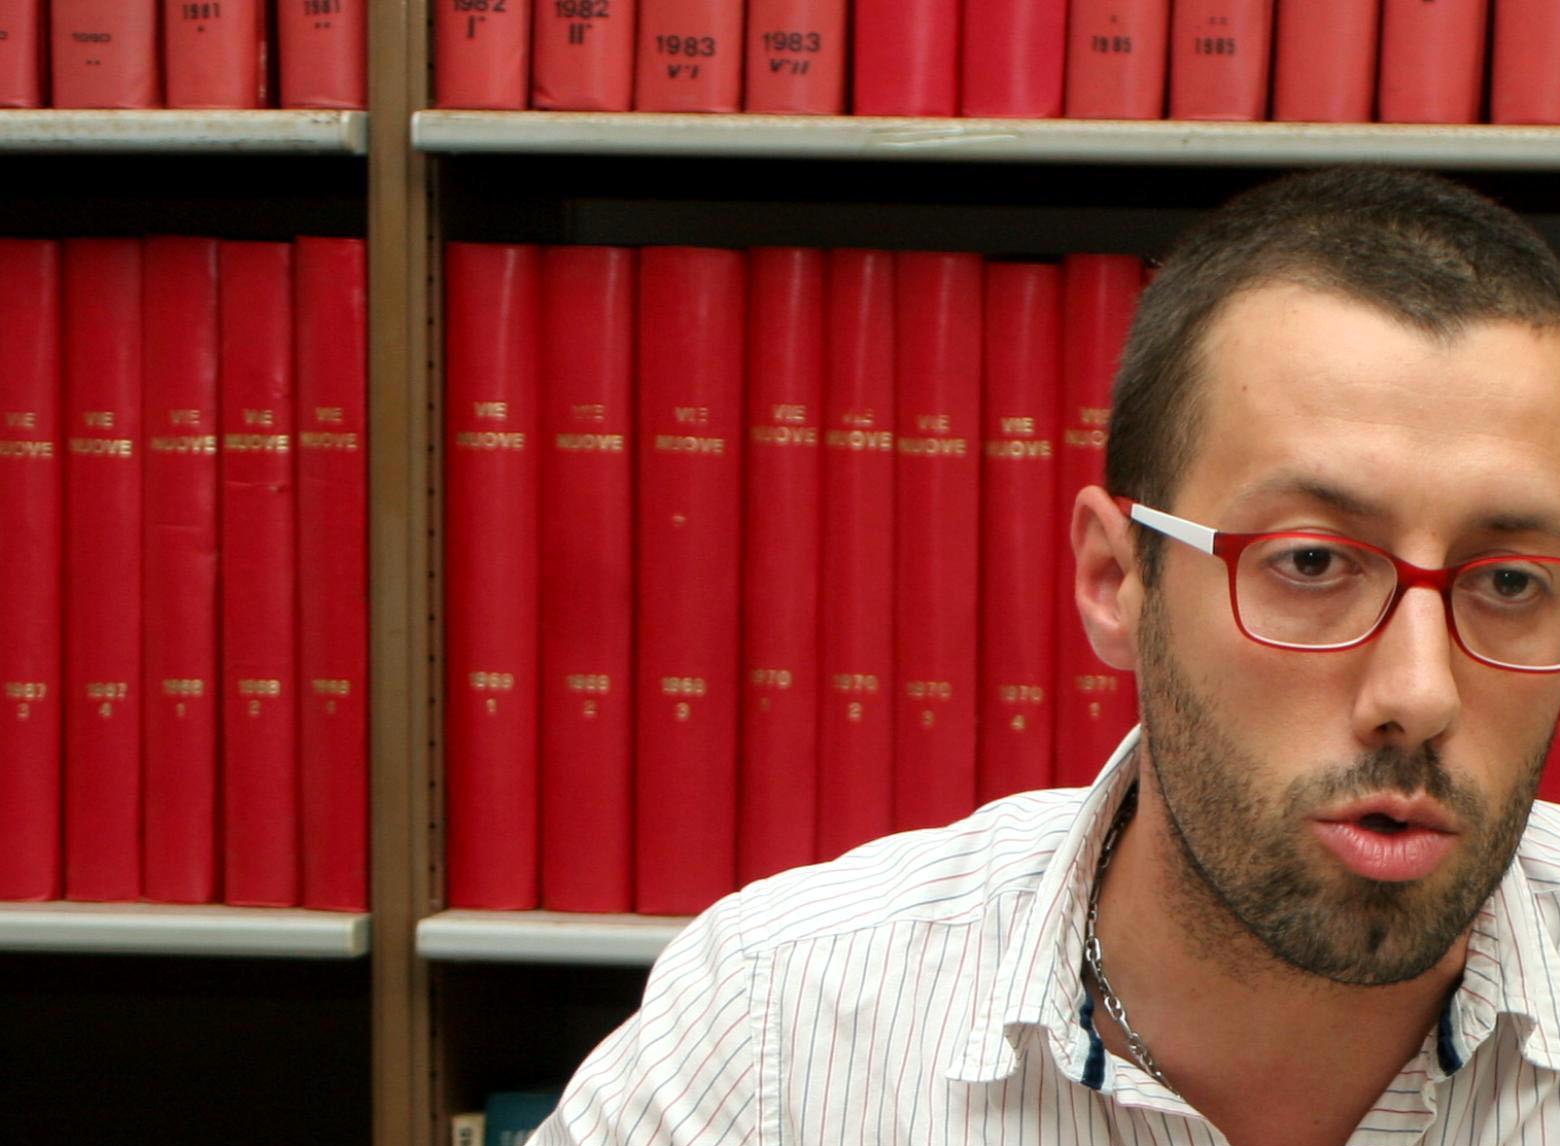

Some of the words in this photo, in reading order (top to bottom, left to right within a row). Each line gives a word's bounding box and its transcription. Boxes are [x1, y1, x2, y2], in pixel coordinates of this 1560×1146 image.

[554, 0, 609, 18] 1982
[655, 35, 716, 57] 1983
[761, 32, 822, 53] 1983
